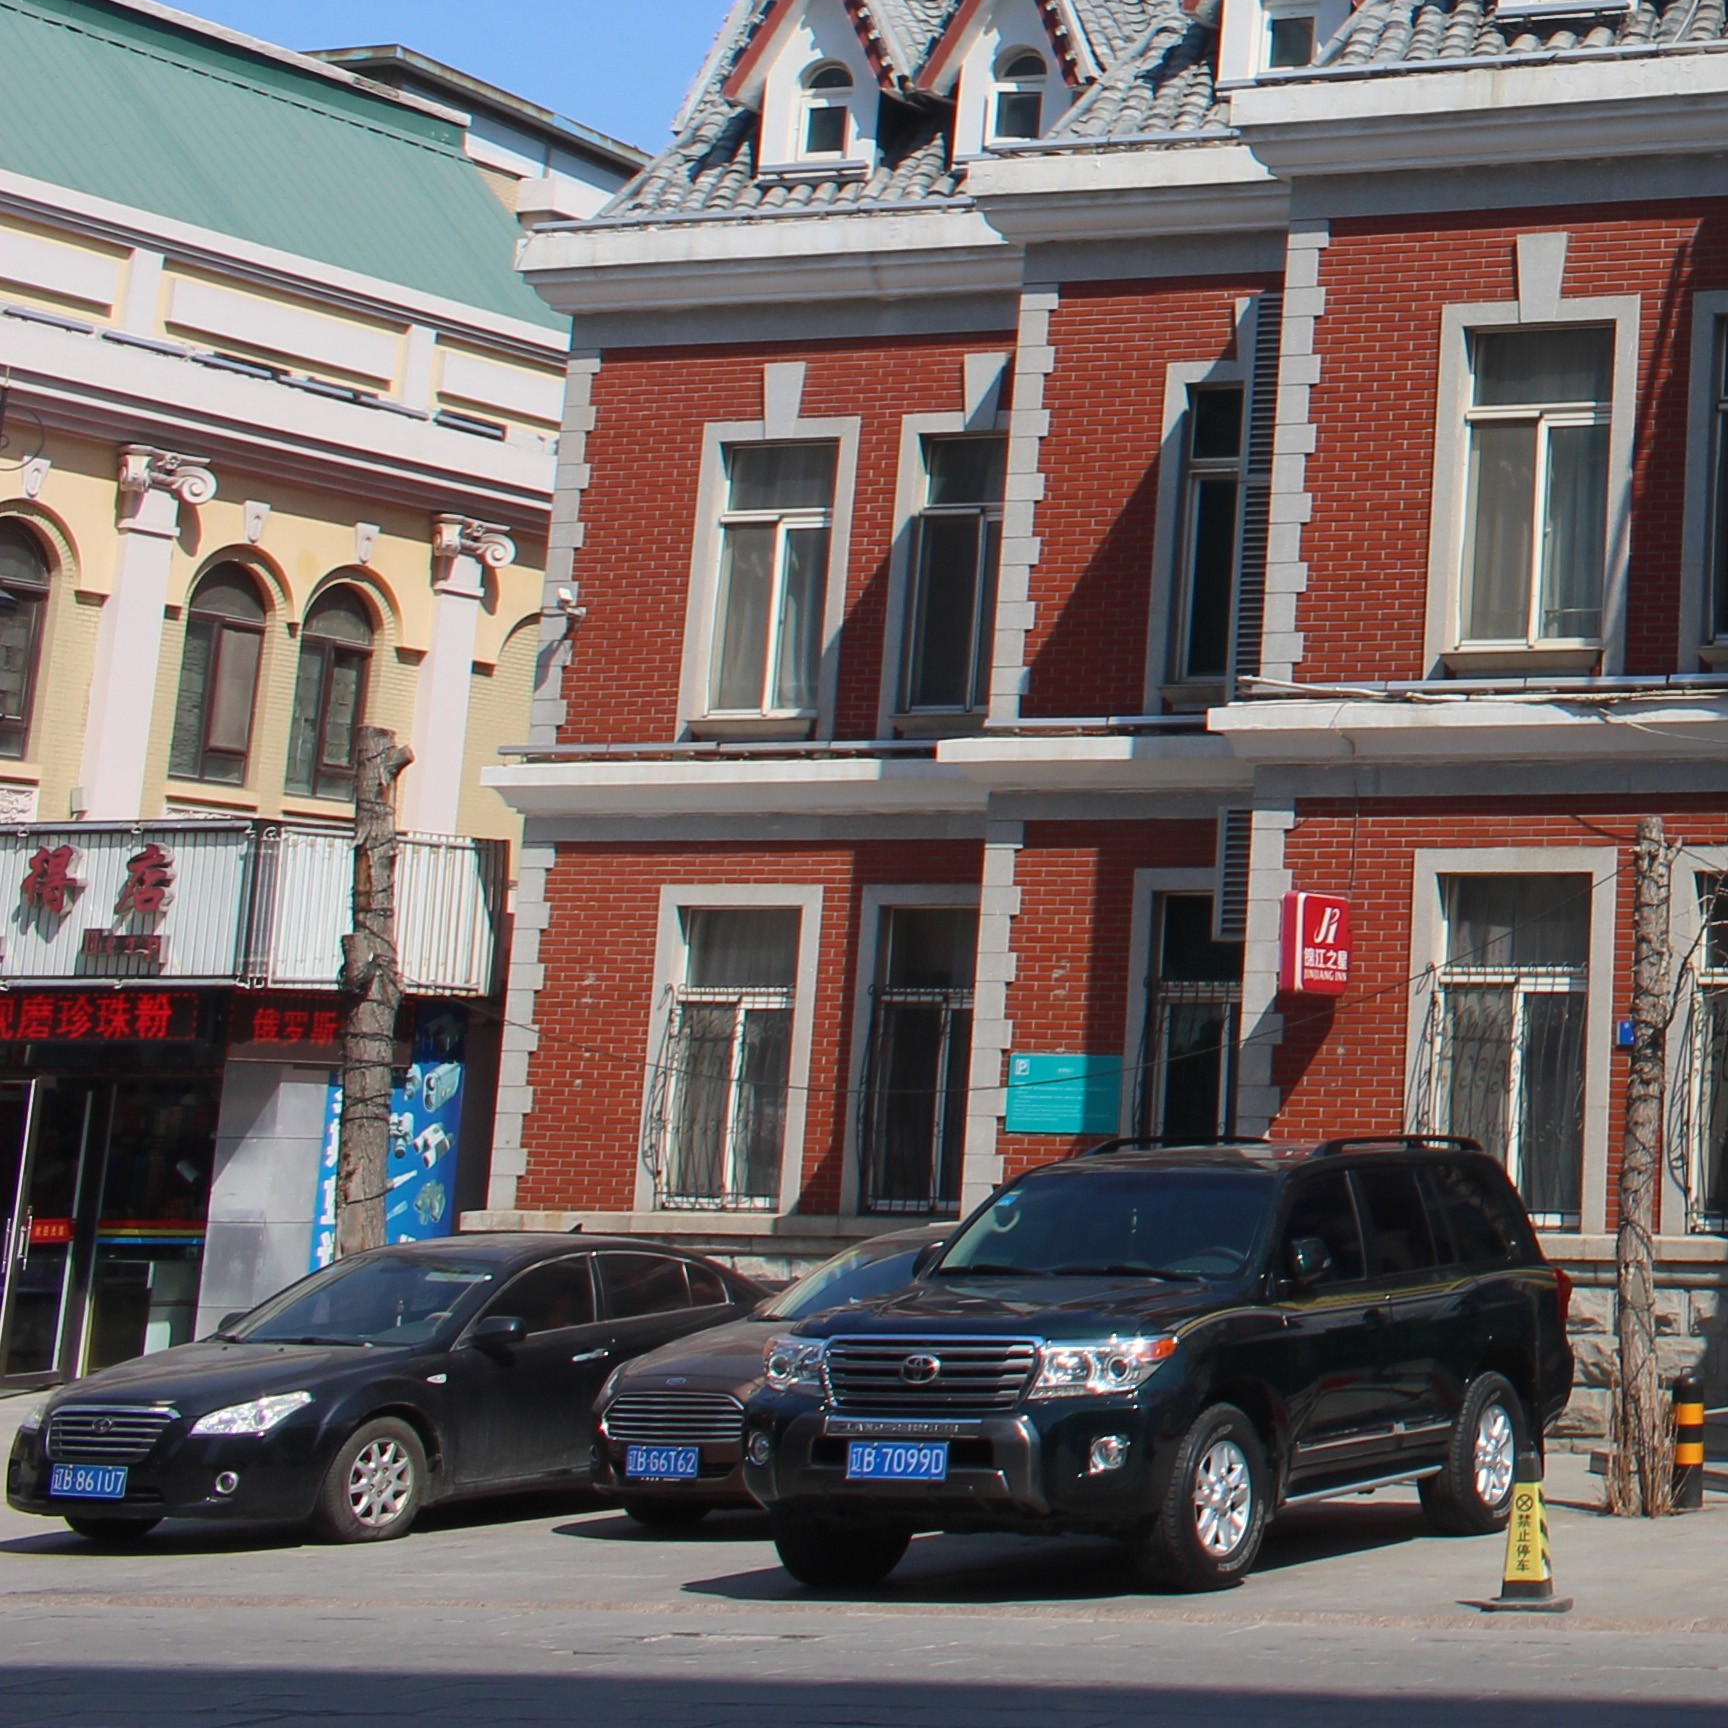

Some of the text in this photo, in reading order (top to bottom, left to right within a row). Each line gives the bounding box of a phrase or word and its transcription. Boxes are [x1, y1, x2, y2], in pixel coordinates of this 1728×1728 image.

[1303, 947, 1348, 971] 锦江之星
[1516, 1513, 1532, 1573] 禁止停车
